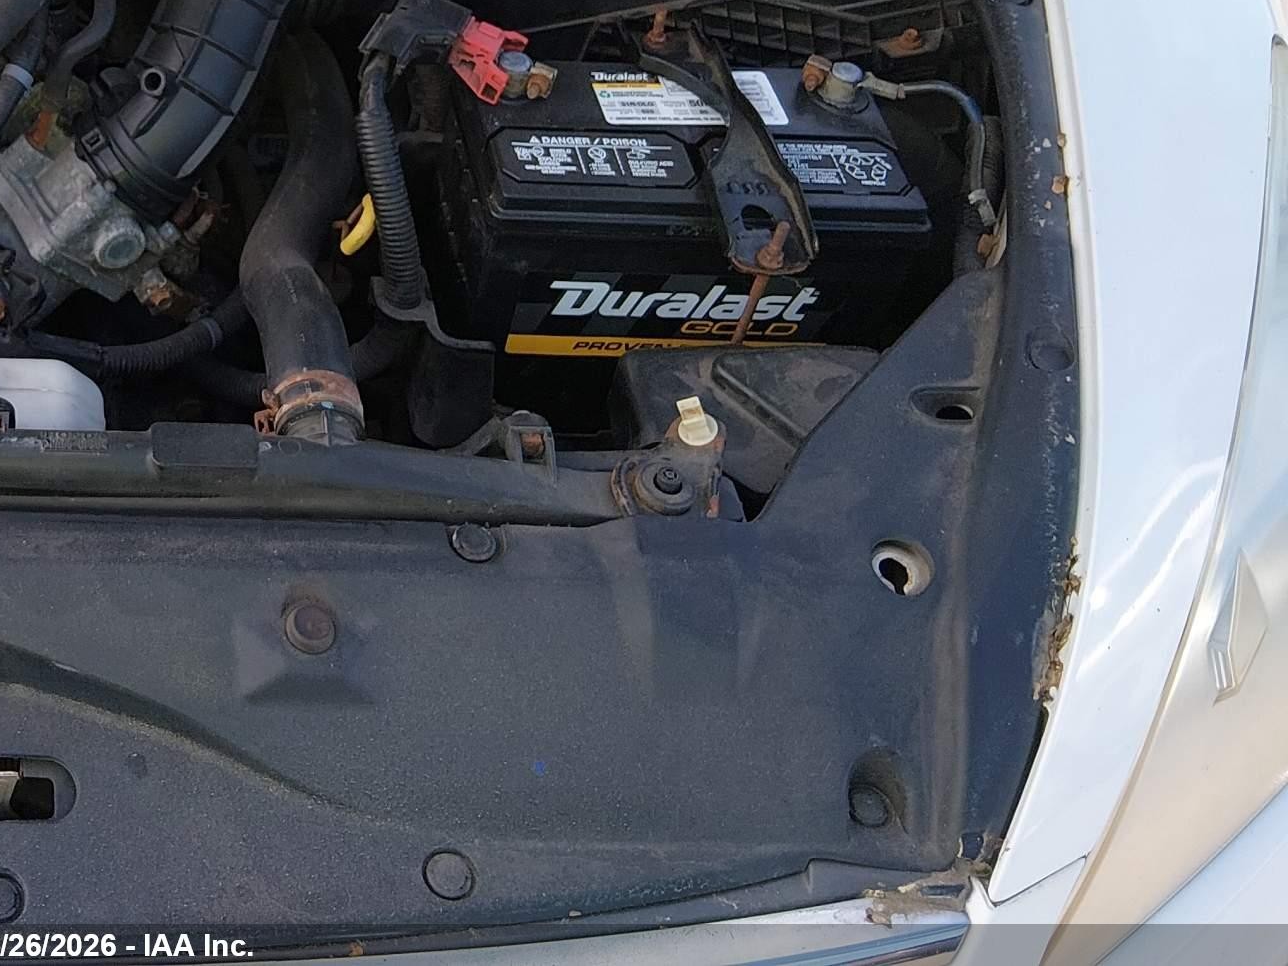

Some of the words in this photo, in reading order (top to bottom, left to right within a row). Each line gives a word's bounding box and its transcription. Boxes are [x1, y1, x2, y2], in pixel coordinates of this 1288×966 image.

[591, 71, 649, 83] Duralast
[542, 136, 591, 146] DANGER
[603, 137, 647, 147] POISON
[550, 280, 820, 321] Duralast
